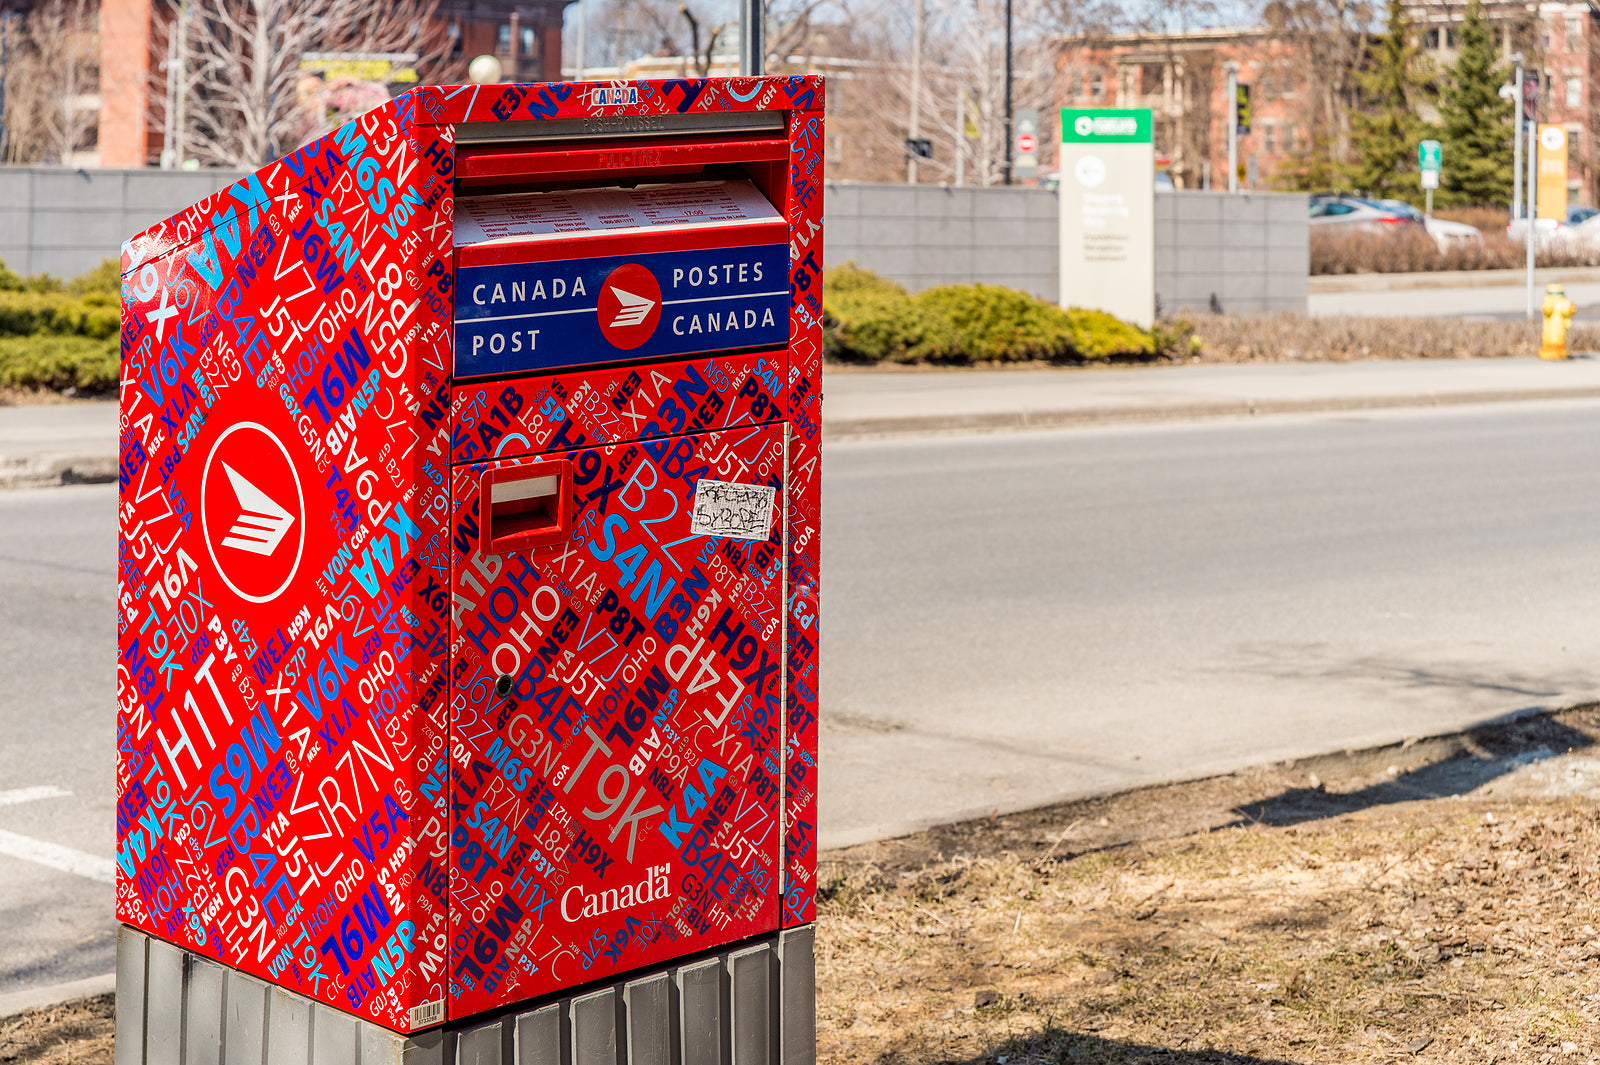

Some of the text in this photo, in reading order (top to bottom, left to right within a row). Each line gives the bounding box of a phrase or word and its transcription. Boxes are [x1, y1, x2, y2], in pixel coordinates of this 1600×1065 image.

[592, 88, 638, 105] CANADA
[583, 115, 665, 132] PUSH-POUSSEZ
[334, 120, 396, 215] M6S
[314, 198, 360, 274] S4N
[683, 209, 703, 217] 17:00
[472, 276, 586, 306] CANADA
[673, 262, 763, 288] POSTES
[472, 329, 540, 356] POST
[672, 307, 775, 336] CANADA
[140, 320, 197, 407] V6K
[192, 367, 216, 409] M6S
[731, 363, 751, 391] M3C
[752, 358, 784, 398] S4N
[279, 383, 302, 421] G6X
[399, 382, 421, 416] Y1A
[461, 390, 487, 430] S7P
[477, 386, 523, 453] A1B
[621, 369, 672, 432] X1A
[640, 363, 710, 463] B3N
[177, 406, 205, 454] S4N
[298, 415, 326, 462] G5N
[169, 479, 193, 533] V5A
[402, 484, 419, 508] M3C
[585, 513, 676, 621] S4N
[595, 587, 646, 647] P8T
[653, 565, 710, 645] B3N
[207, 614, 238, 664] P3Y
[708, 606, 780, 699] H9X
[295, 632, 360, 721] V6K
[548, 649, 576, 682] Y1A
[563, 666, 606, 706] J5T
[157, 651, 234, 791] H1T
[512, 657, 583, 741] B4E
[484, 735, 534, 791] M6S
[524, 789, 555, 830] B3N
[562, 724, 665, 865] T9K
[658, 757, 728, 850] K4A
[352, 793, 411, 864] V5A
[466, 800, 517, 859] S4N
[710, 821, 733, 849] Y1A
[722, 831, 758, 868] J5T
[528, 848, 555, 878] P3Y
[680, 827, 738, 902] B4E
[225, 866, 276, 963] G3N
[377, 867, 405, 917] S4N
[560, 865, 671, 923] Canada
[708, 903, 732, 931] H1T
[293, 921, 330, 996] T9K
[371, 919, 417, 987] N5P
[504, 918, 532, 960] N5P
